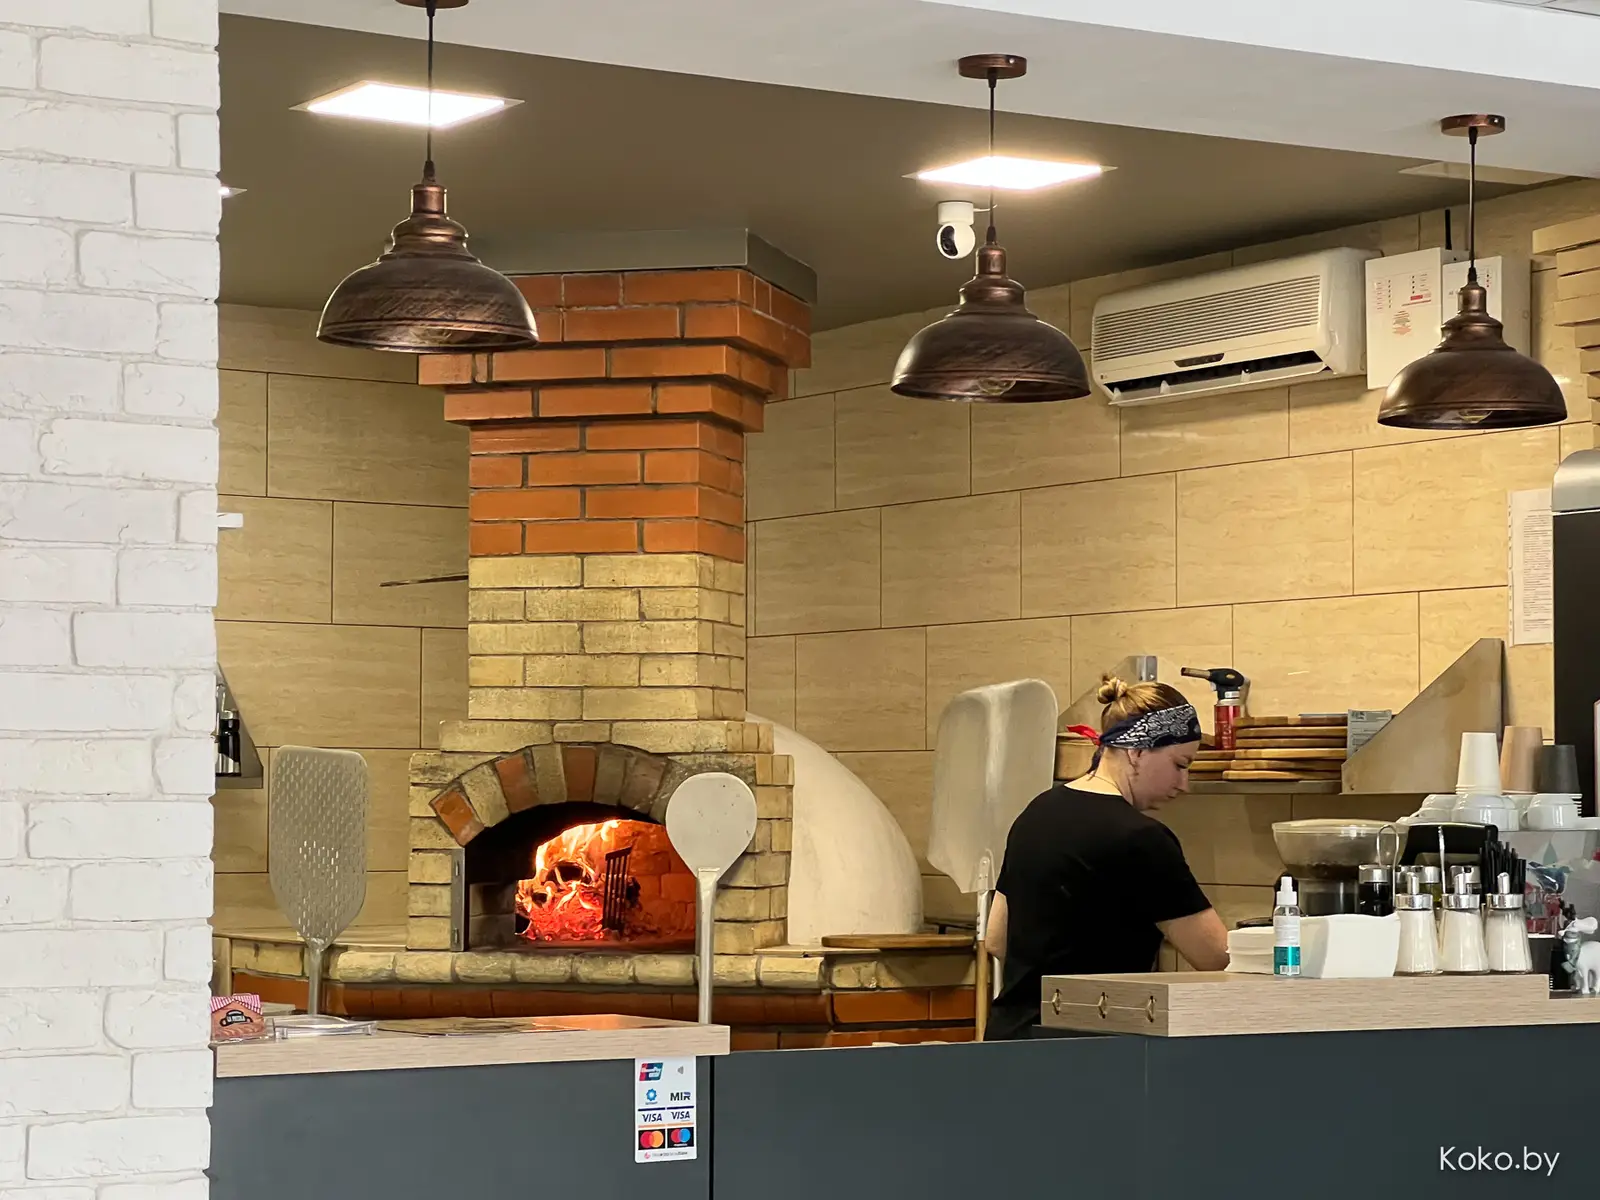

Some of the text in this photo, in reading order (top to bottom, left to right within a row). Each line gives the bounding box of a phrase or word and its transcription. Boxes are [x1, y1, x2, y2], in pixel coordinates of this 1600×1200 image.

[670, 1092, 691, 1101] MIR
[642, 1113, 663, 1122] VISA
[671, 1111, 690, 1120] VISA
